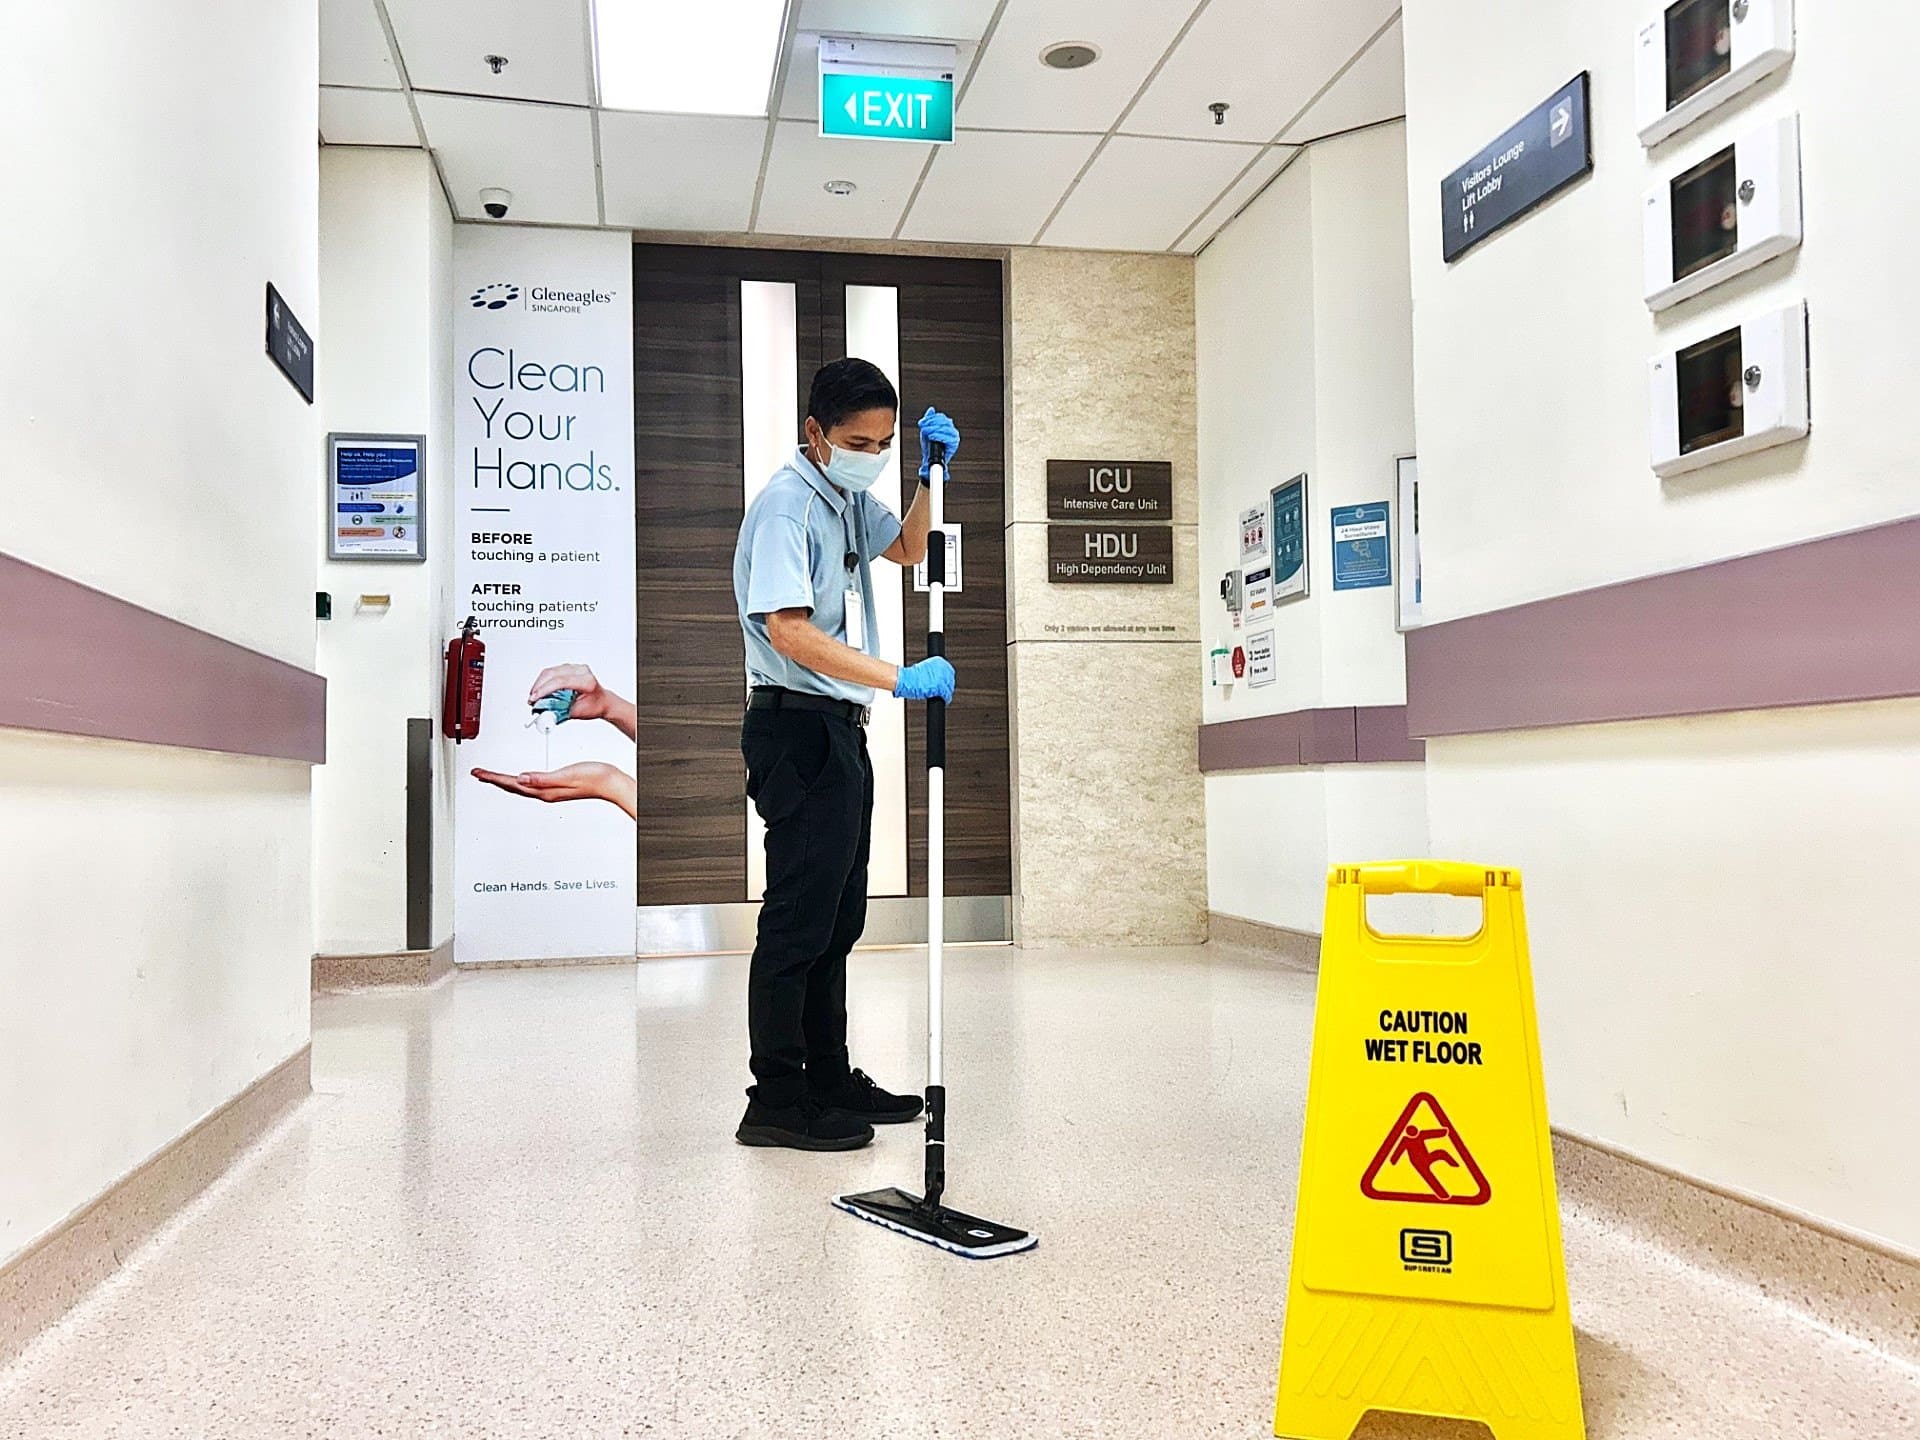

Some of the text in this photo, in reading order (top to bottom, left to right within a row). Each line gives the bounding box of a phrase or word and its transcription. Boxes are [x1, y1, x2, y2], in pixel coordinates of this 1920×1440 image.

[863, 91, 932, 129] EXIT
[1462, 141, 1525, 193] Visitors Lounge
[1461, 175, 1502, 211] Lift Lobby
[531, 304, 581, 314] SINGAPORE
[468, 347, 604, 393] Clean
[472, 396, 577, 441] Your
[474, 447, 620, 491] Hands.
[1089, 468, 1132, 493] ICU
[1063, 497, 1158, 510] Intensive Care Unit
[471, 533, 533, 545] BEFORE
[1084, 533, 1138, 558] HDU
[471, 550, 601, 563] touching a patient
[1056, 563, 1167, 576] High Dependency Unit
[471, 584, 521, 595] AFTER
[471, 600, 598, 614] touching patients'
[471, 616, 565, 630] surroundings
[1044, 624, 1059, 633] Only
[473, 879, 618, 892] Clean Hands. Save Lives.
[1379, 1010, 1467, 1034] CAUTION
[1365, 1039, 1483, 1065] WET FLOOR
[1411, 1236, 1442, 1258] S
